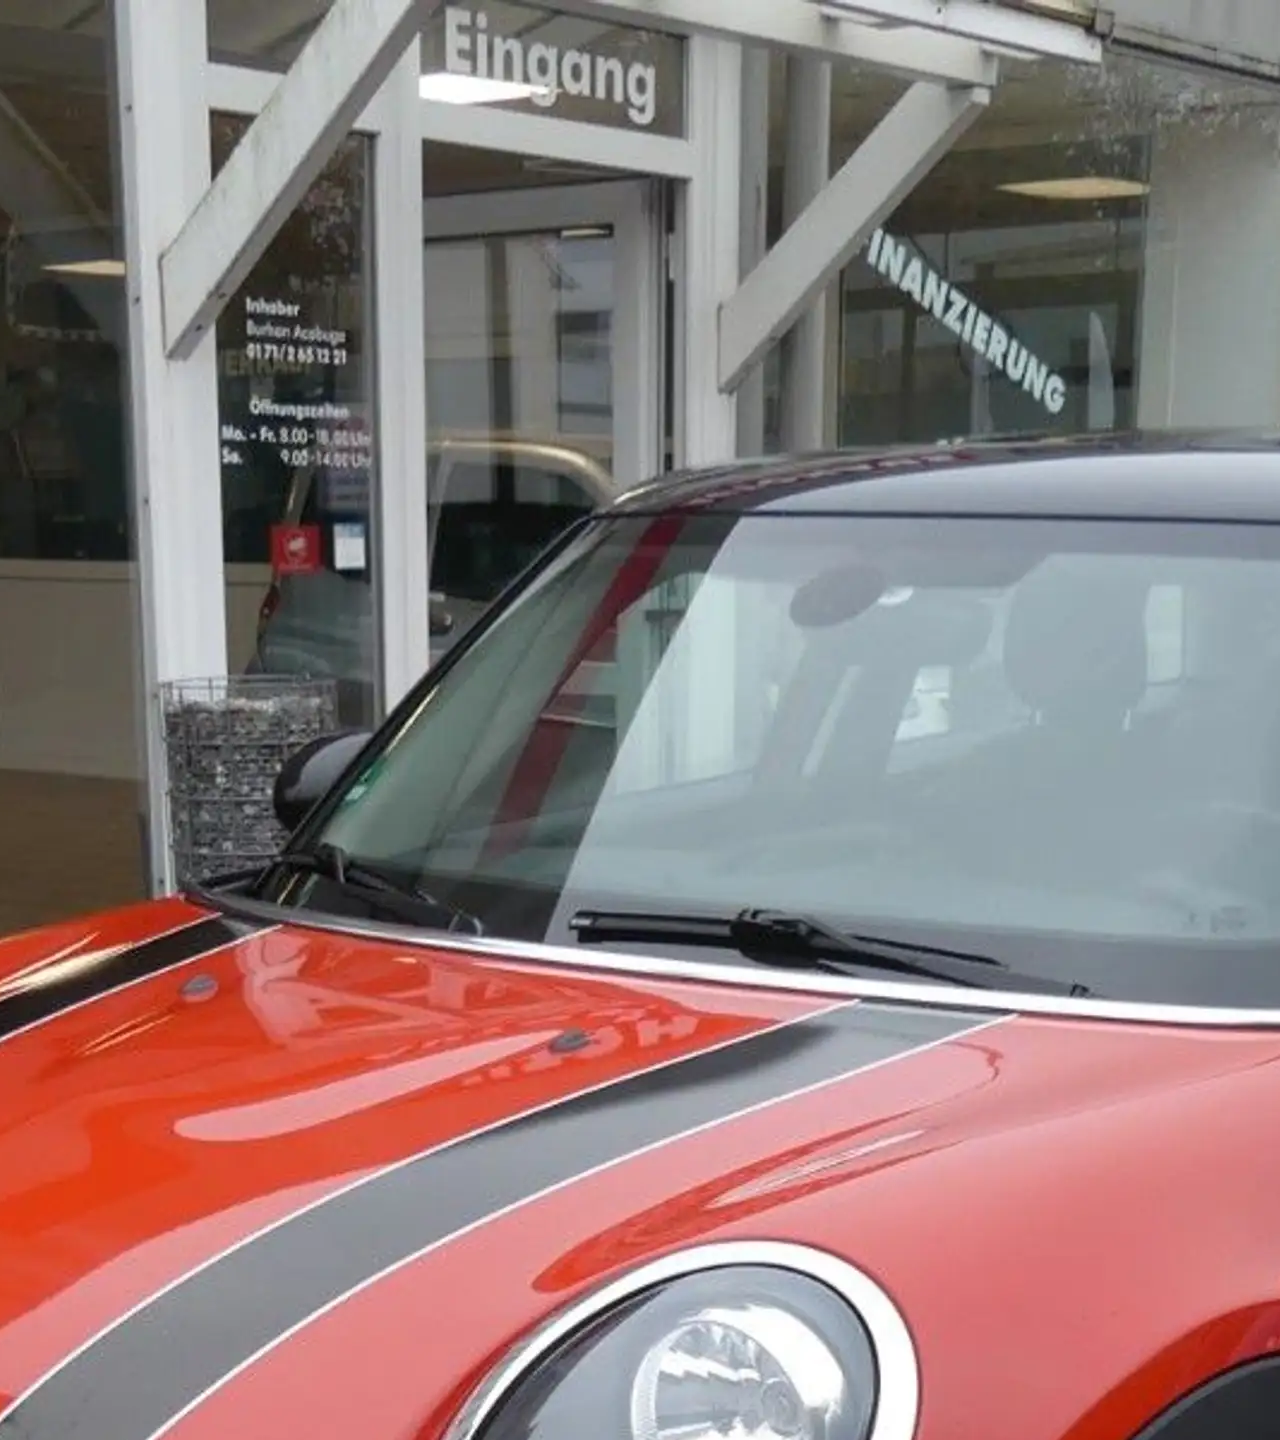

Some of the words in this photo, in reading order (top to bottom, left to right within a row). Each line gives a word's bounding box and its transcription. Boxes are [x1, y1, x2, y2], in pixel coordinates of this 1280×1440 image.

[444, 6, 657, 126] Eingang
[245, 296, 301, 317] Inhaber
[862, 228, 1067, 415] INANZIERUNG
[249, 394, 351, 421] Öffnungszeiten
[221, 424, 247, 441] Mo.
[259, 425, 277, 443] Fr.
